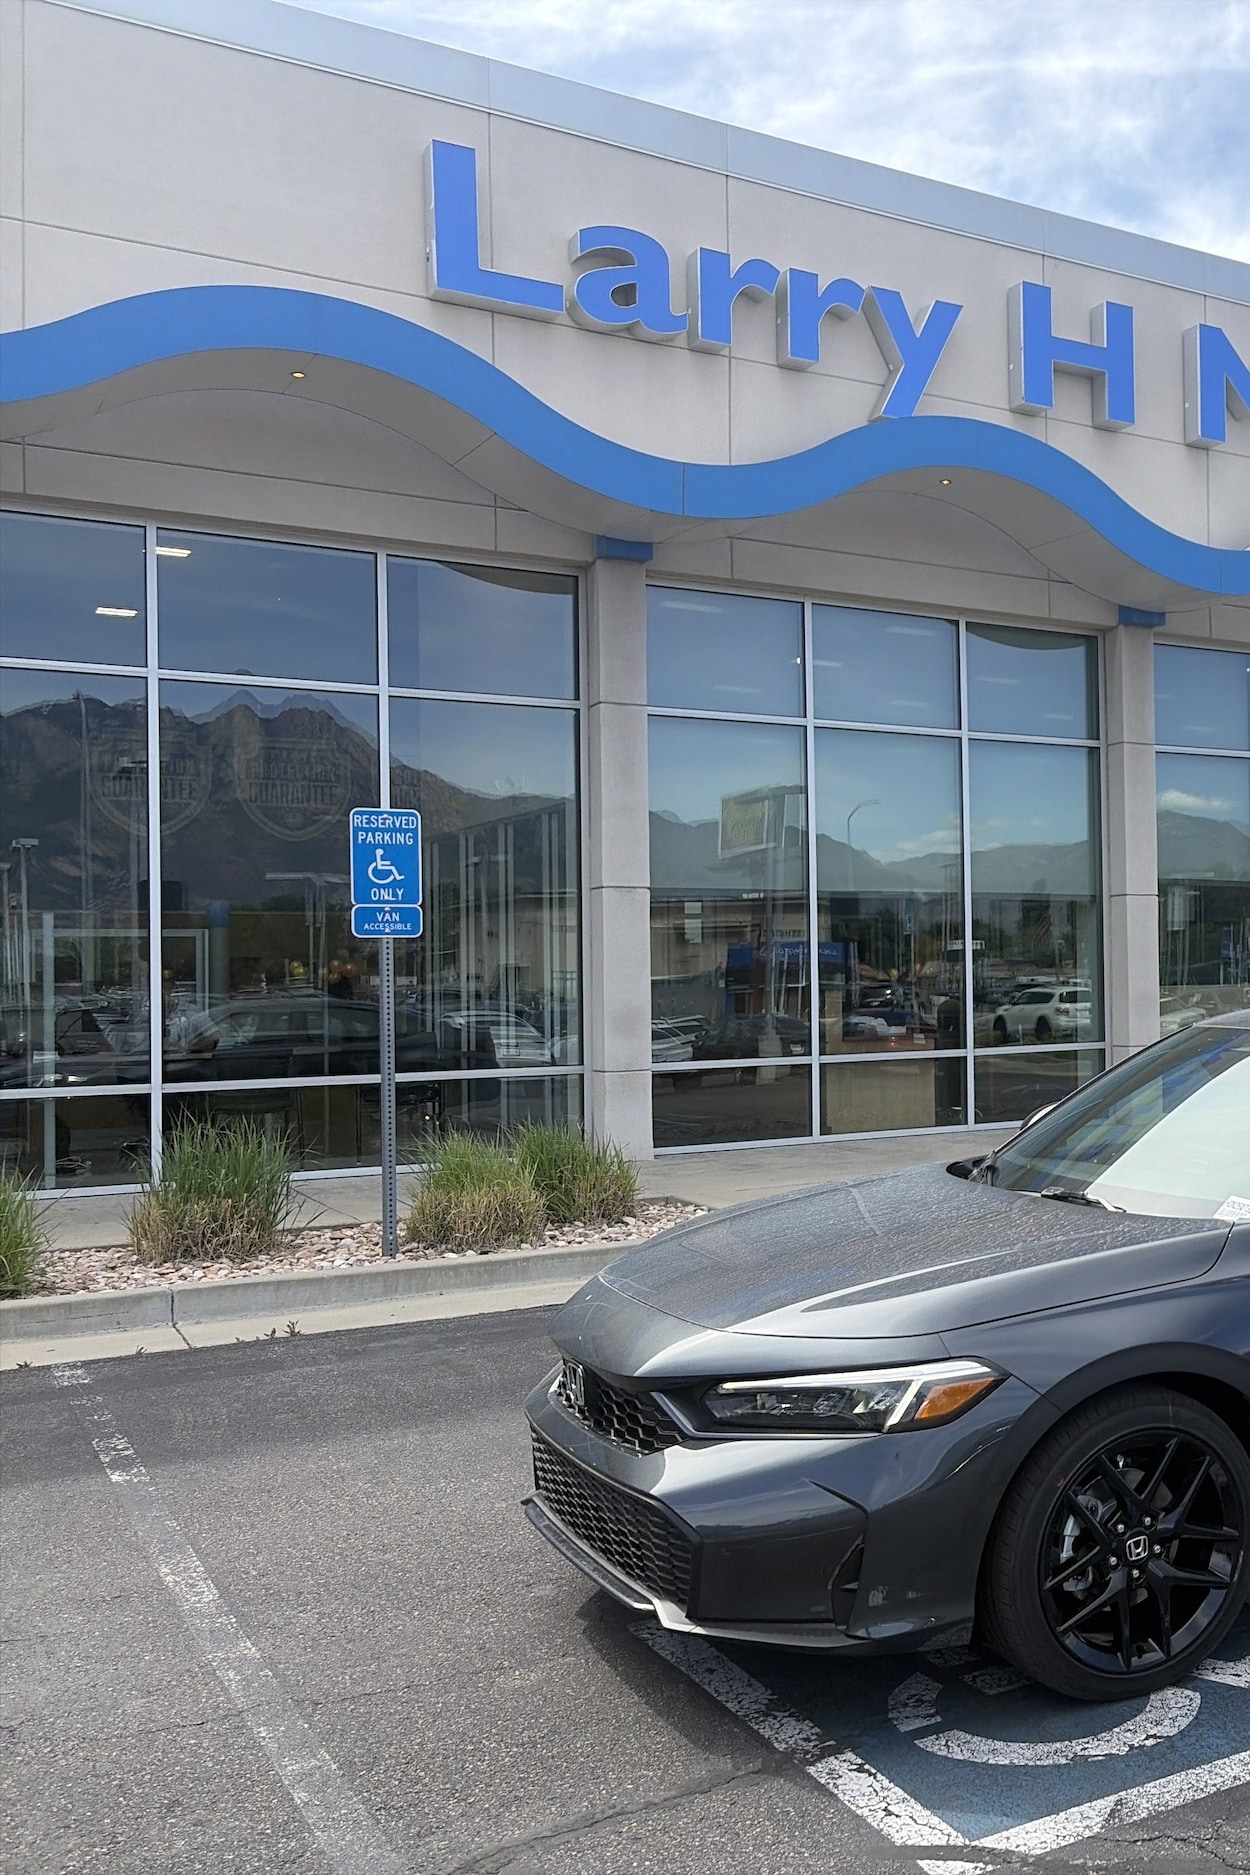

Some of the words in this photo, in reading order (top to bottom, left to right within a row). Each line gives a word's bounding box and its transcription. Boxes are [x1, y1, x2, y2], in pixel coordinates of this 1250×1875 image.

[425, 139, 963, 421] Larry
[1011, 269, 1135, 429] H
[101, 775, 198, 800] GUARNTEE
[353, 814, 417, 829] RESERVED
[358, 832, 414, 845] PARKING
[371, 888, 404, 901] ONLY
[376, 912, 400, 922] VAN
[364, 923, 412, 931] ACCESSIBLE
